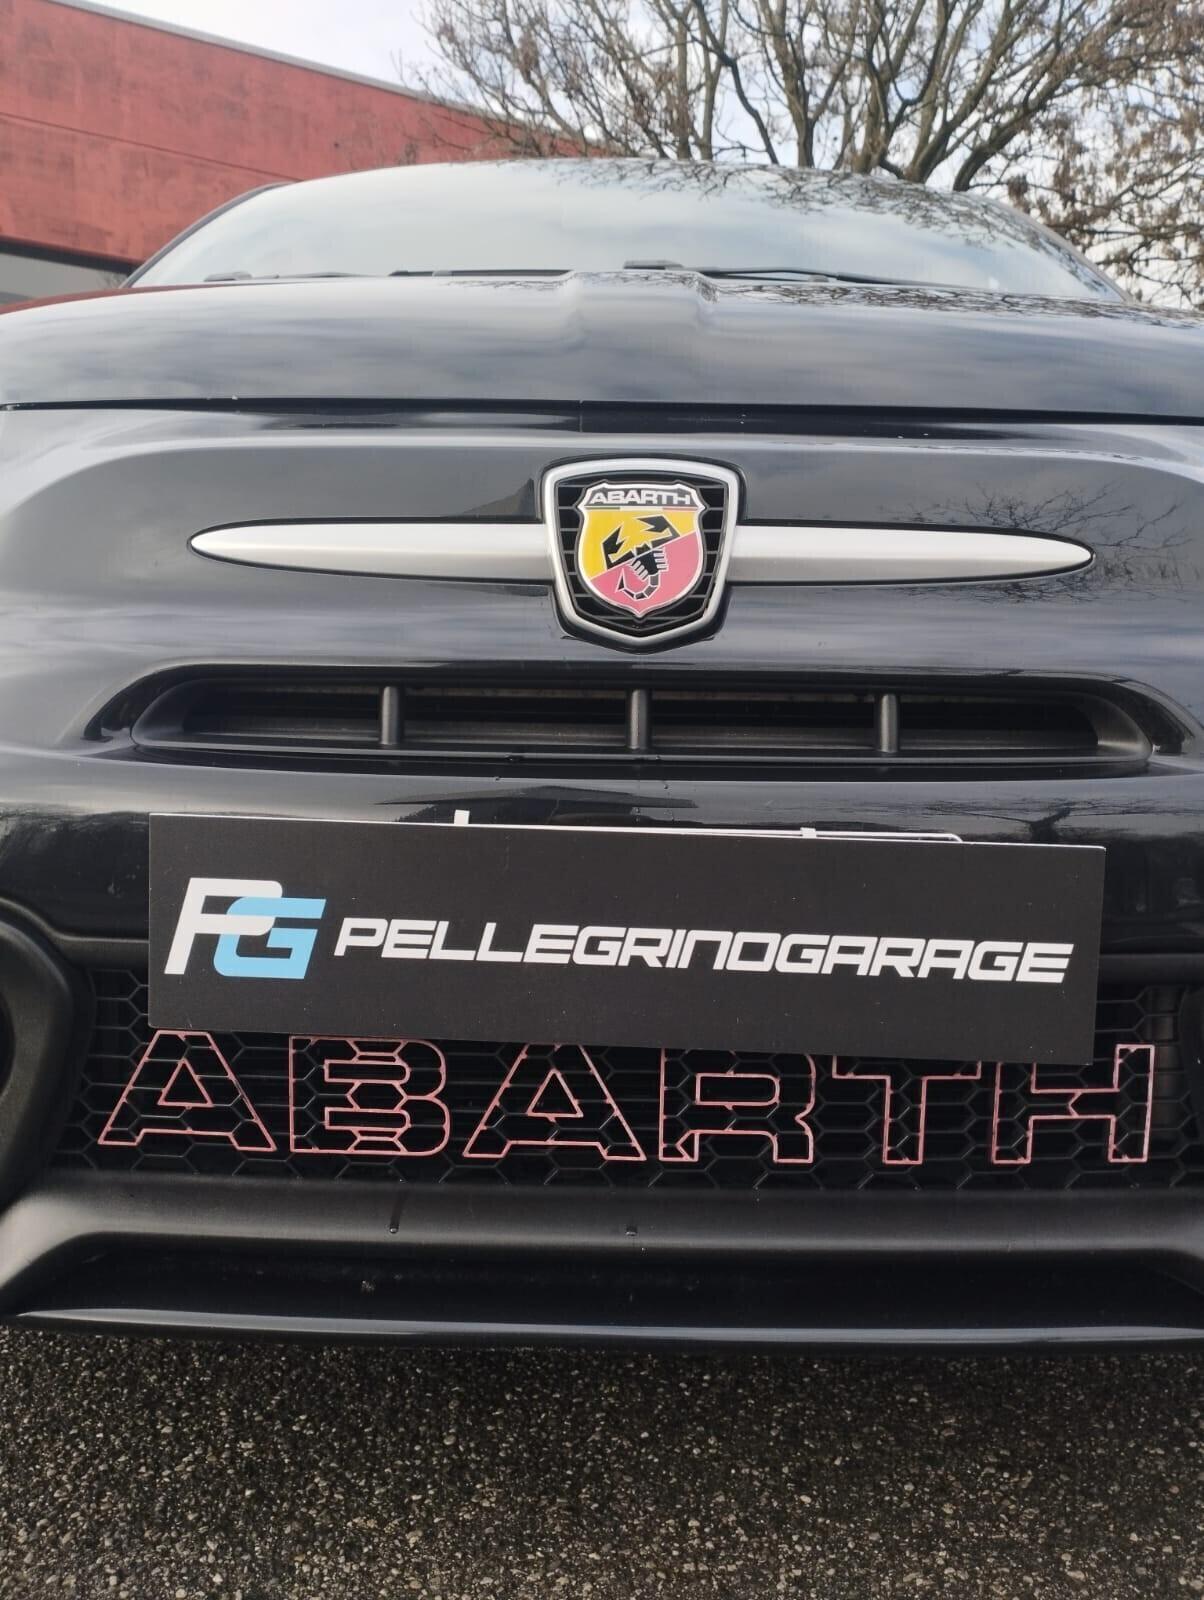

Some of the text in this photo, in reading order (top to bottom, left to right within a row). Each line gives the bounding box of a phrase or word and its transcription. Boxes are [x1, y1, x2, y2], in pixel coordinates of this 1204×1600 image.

[590, 490, 690, 505] ABARTH
[334, 917, 1074, 984] PELLEGRINOGARAGE
[98, 1030, 1155, 1164] ABARTH
